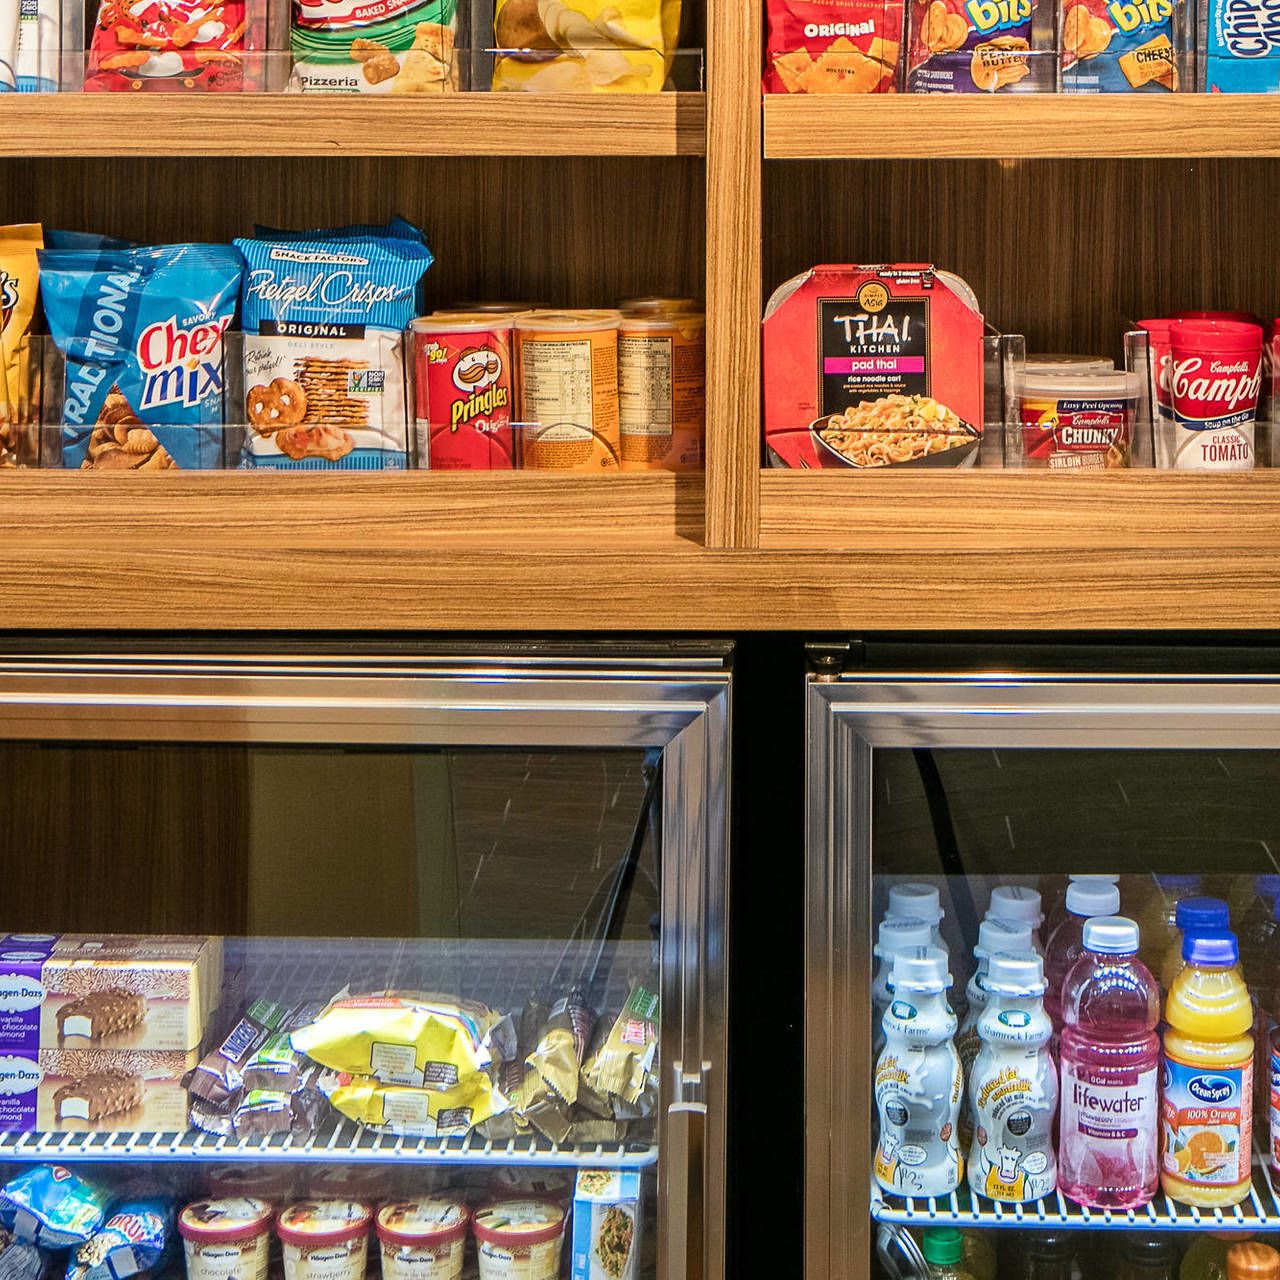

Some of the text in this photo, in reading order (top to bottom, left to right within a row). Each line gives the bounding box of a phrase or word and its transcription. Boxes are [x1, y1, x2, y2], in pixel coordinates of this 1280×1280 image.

[354, 1, 387, 20] BAKED
[299, 75, 359, 89] Pizzeria
[274, 250, 366, 264] SNACK FACTORY
[245, 269, 324, 315] Pretzel
[277, 323, 347, 336] ORIGINAL
[832, 313, 910, 346] THAI
[139, 315, 230, 370] Chex
[849, 345, 901, 354] KITCHEN
[851, 359, 897, 372] pad thai
[144, 362, 224, 407] mix
[847, 374, 886, 383] rice noodle
[450, 382, 509, 432] Pringles
[1062, 402, 1080, 410] Easy
[1204, 412, 1250, 430] Soup the Go
[1061, 426, 1120, 446] CHUNKY
[1212, 434, 1241, 445] CLASSIC
[1200, 442, 1250, 463] TOMATO
[0, 1015, 25, 1024] vanilla
[0, 1023, 39, 1031] chocolate
[1073, 1083, 1144, 1114] lifewater
[1186, 1108, 1238, 1121] 100% Orange
